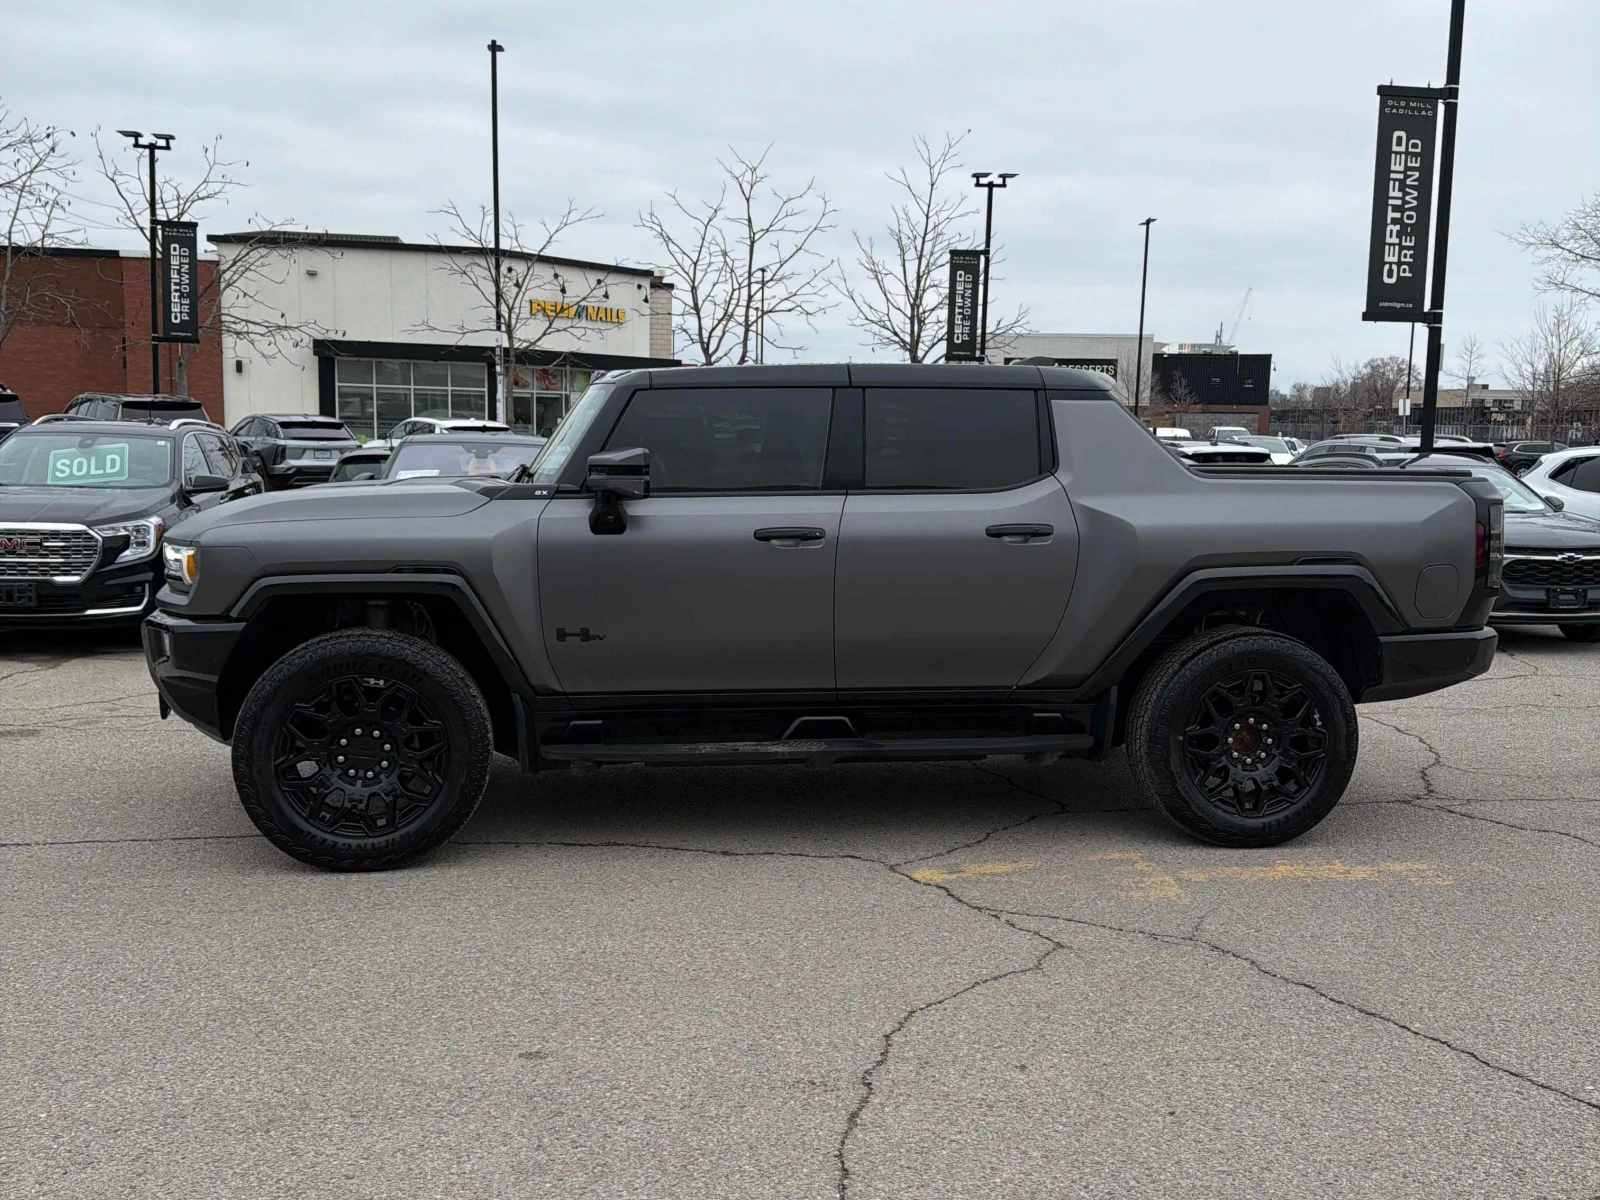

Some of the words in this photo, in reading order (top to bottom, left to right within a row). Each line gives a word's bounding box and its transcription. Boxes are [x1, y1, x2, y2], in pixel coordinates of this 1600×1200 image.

[1384, 108, 1434, 117] CADILLAC
[1382, 130, 1407, 285] CERTIFIED
[1399, 138, 1422, 278] PRE-OWNED
[170, 243, 181, 324] CERTIFIED
[181, 247, 190, 320] PRE-OWNED
[586, 305, 626, 324] NAILS
[954, 270, 965, 344] CERTIFIED
[962, 274, 973, 340] PRE-OWNED
[1378, 301, 1413, 309] oldmillgm.ca
[55, 454, 121, 478] SOLD
[0, 538, 42, 550] MC
